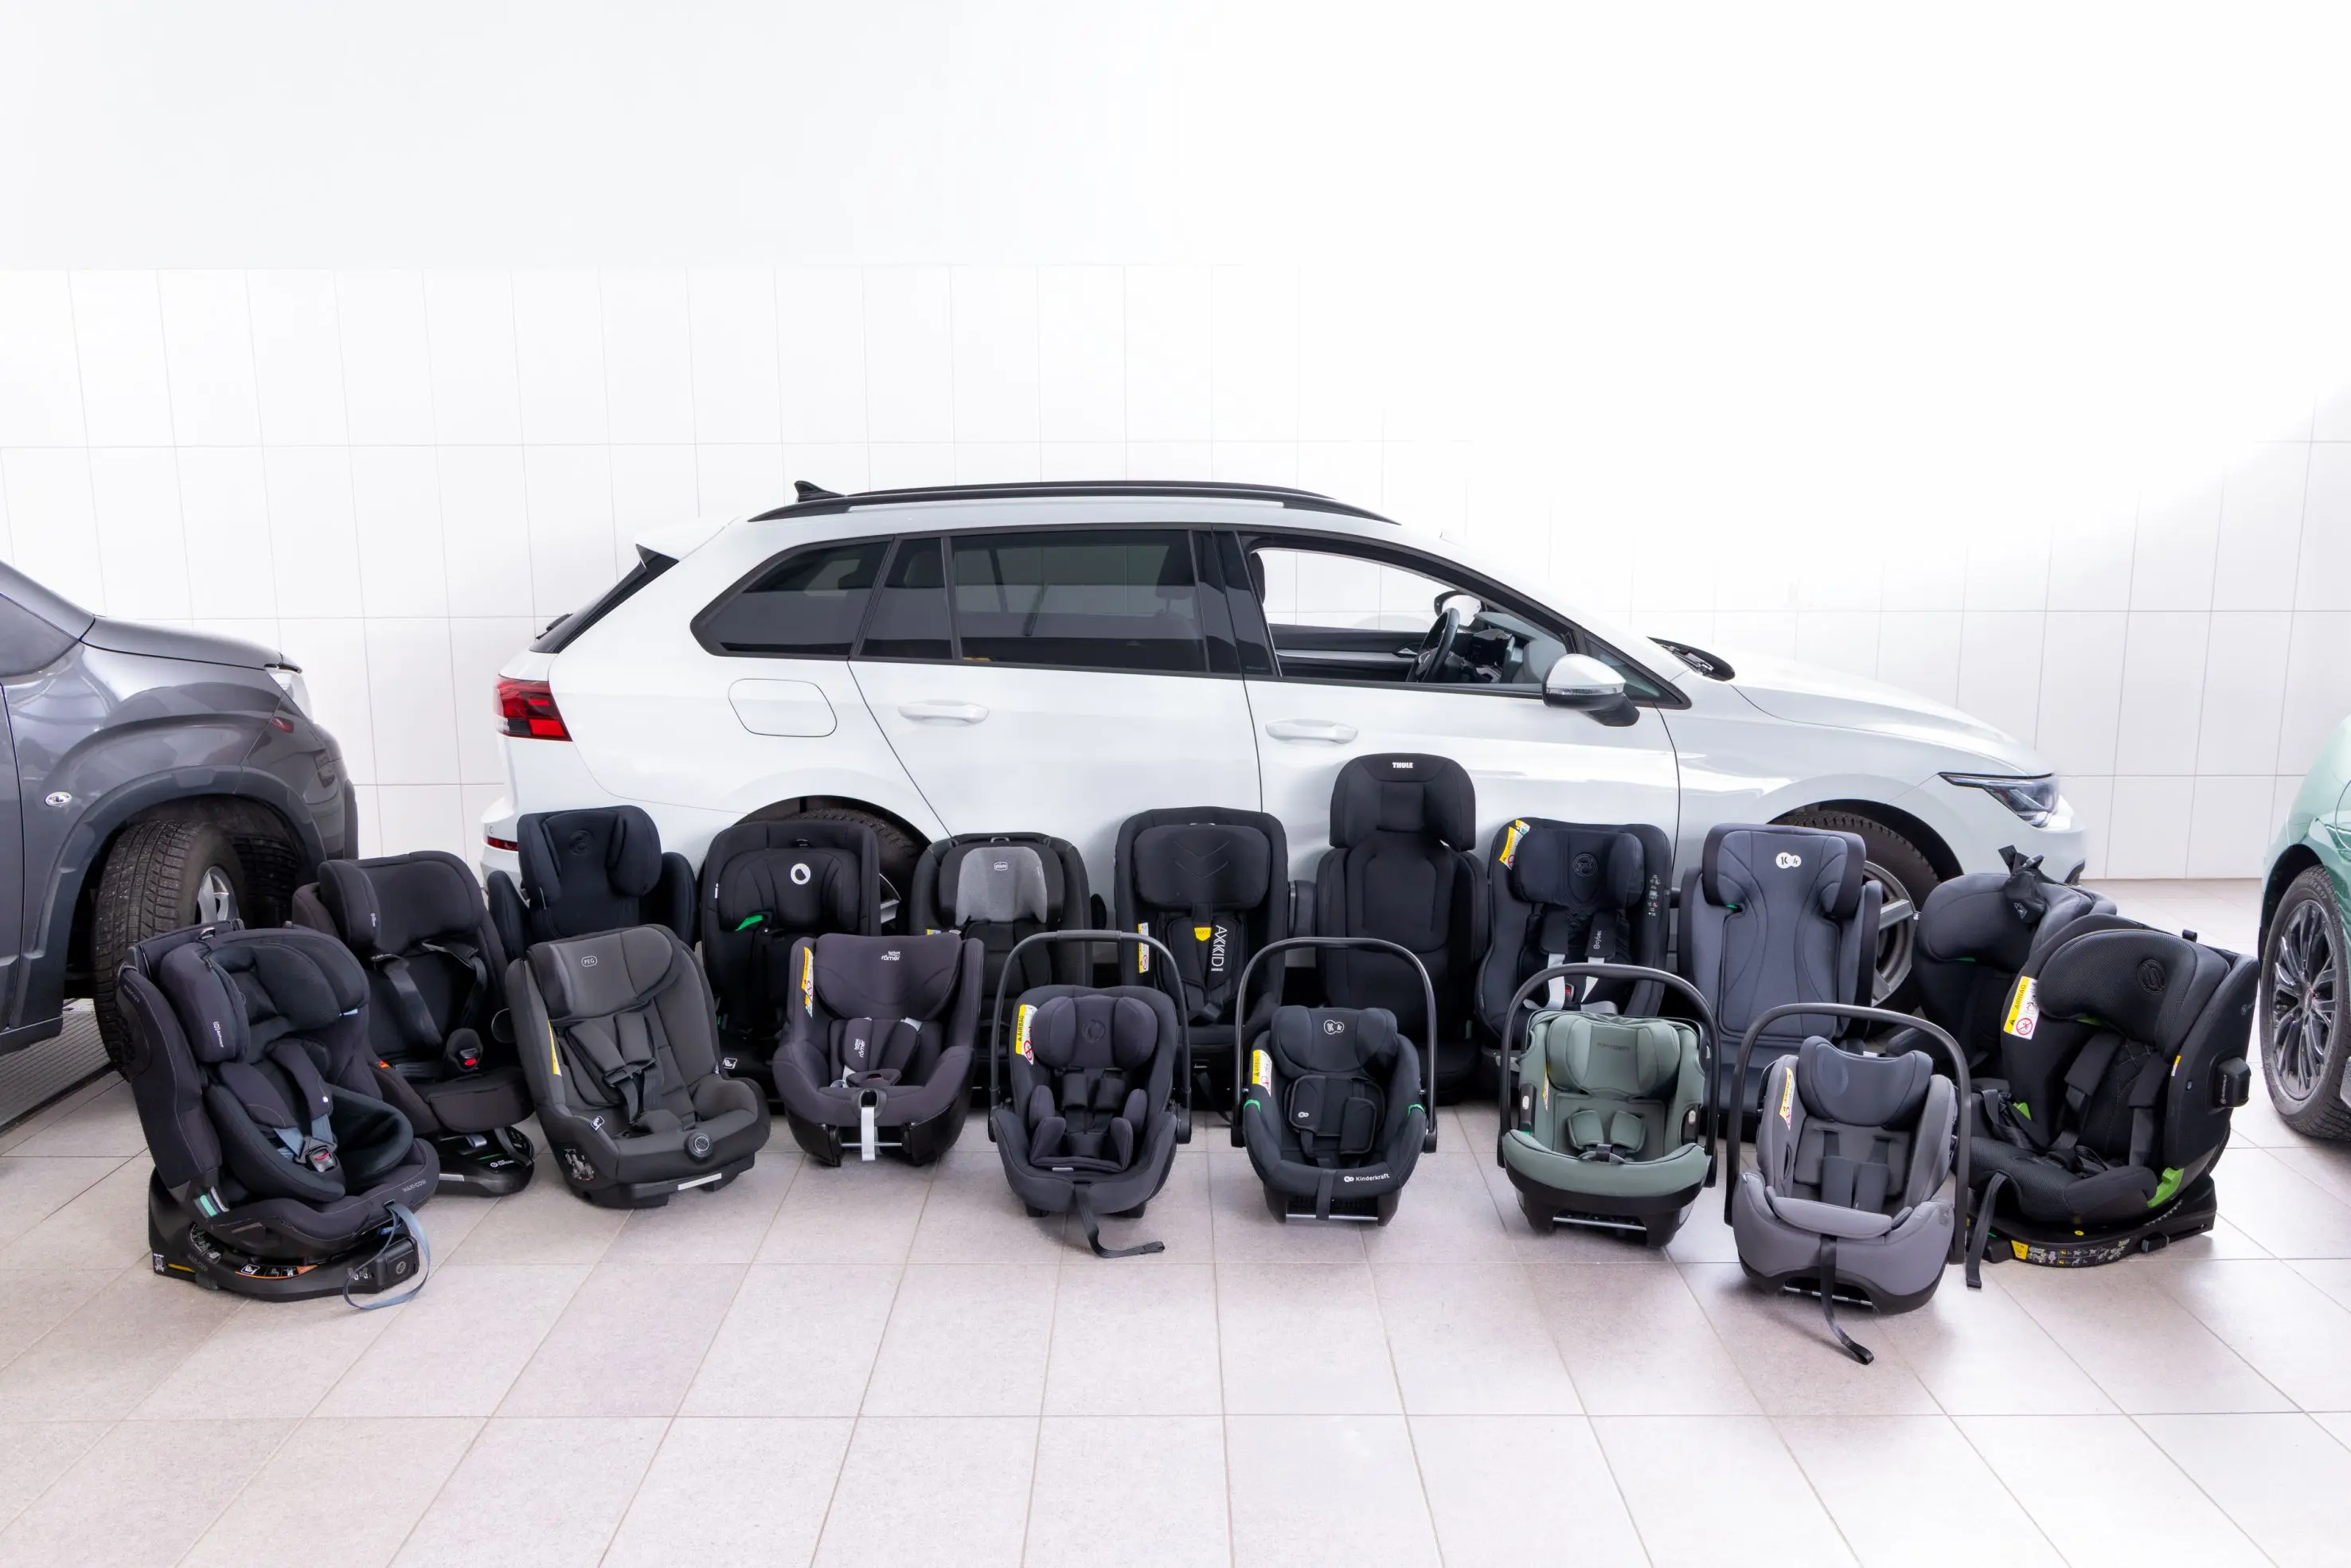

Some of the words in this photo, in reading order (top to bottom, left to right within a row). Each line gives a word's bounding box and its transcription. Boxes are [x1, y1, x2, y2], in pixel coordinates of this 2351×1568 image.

[1211, 924, 1228, 967] AXKID
[2014, 984, 2026, 1010] AIRBAG
[1355, 1172, 1390, 1181] Kinderkraft
